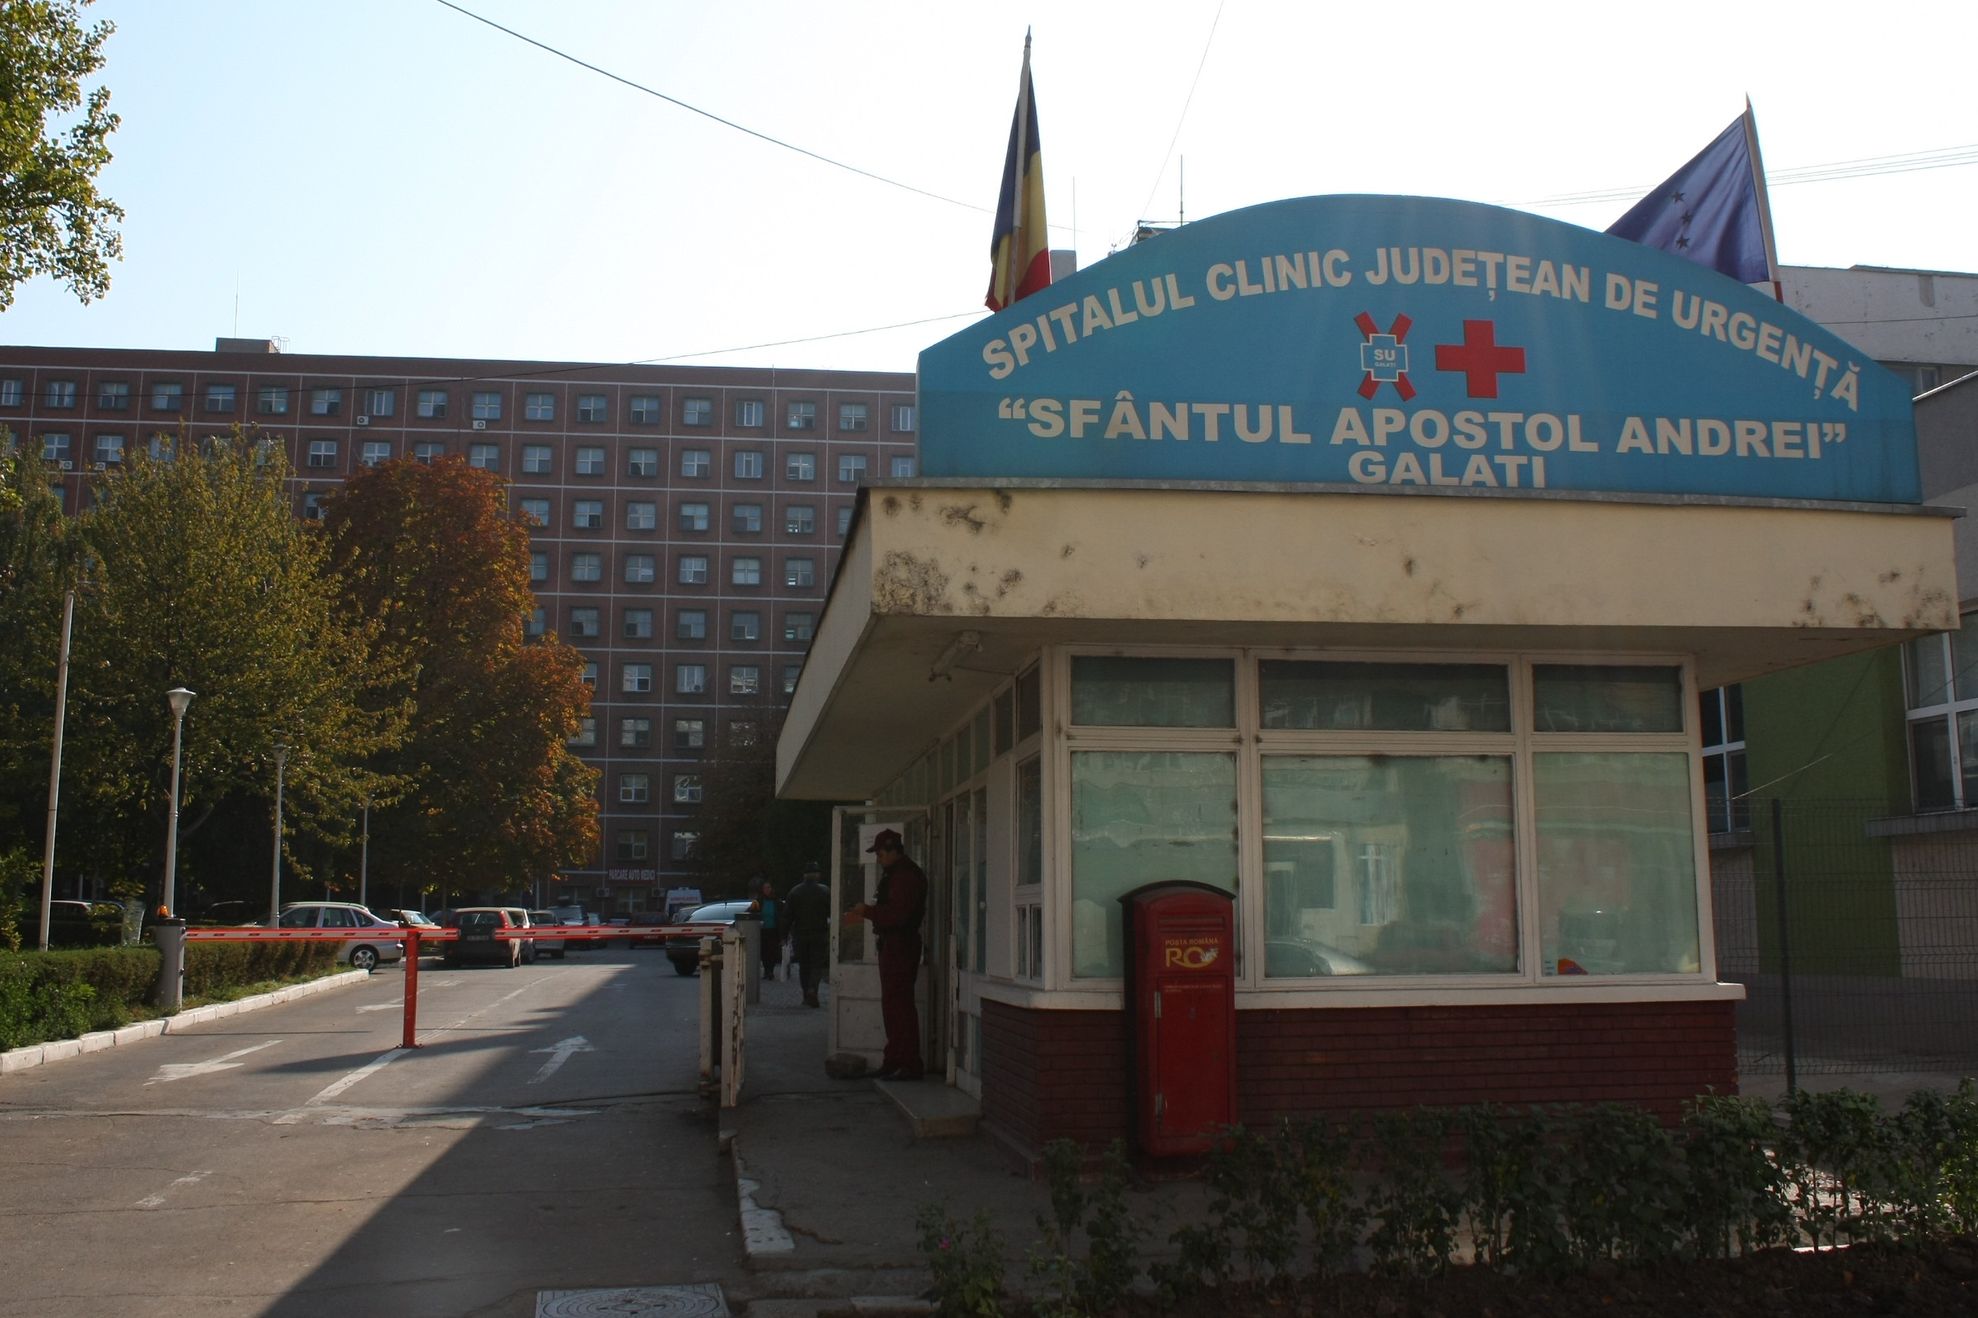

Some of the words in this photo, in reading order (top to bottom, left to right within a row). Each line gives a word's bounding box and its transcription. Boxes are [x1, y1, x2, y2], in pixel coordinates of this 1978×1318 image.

[983, 274, 1195, 380] SPITALUL
[1206, 249, 1353, 301] CLINIC
[1605, 272, 1659, 319] DE
[1373, 348, 1396, 361] SU
[1330, 407, 1599, 453] APOSTOL
[1348, 450, 1546, 489] GALATI
